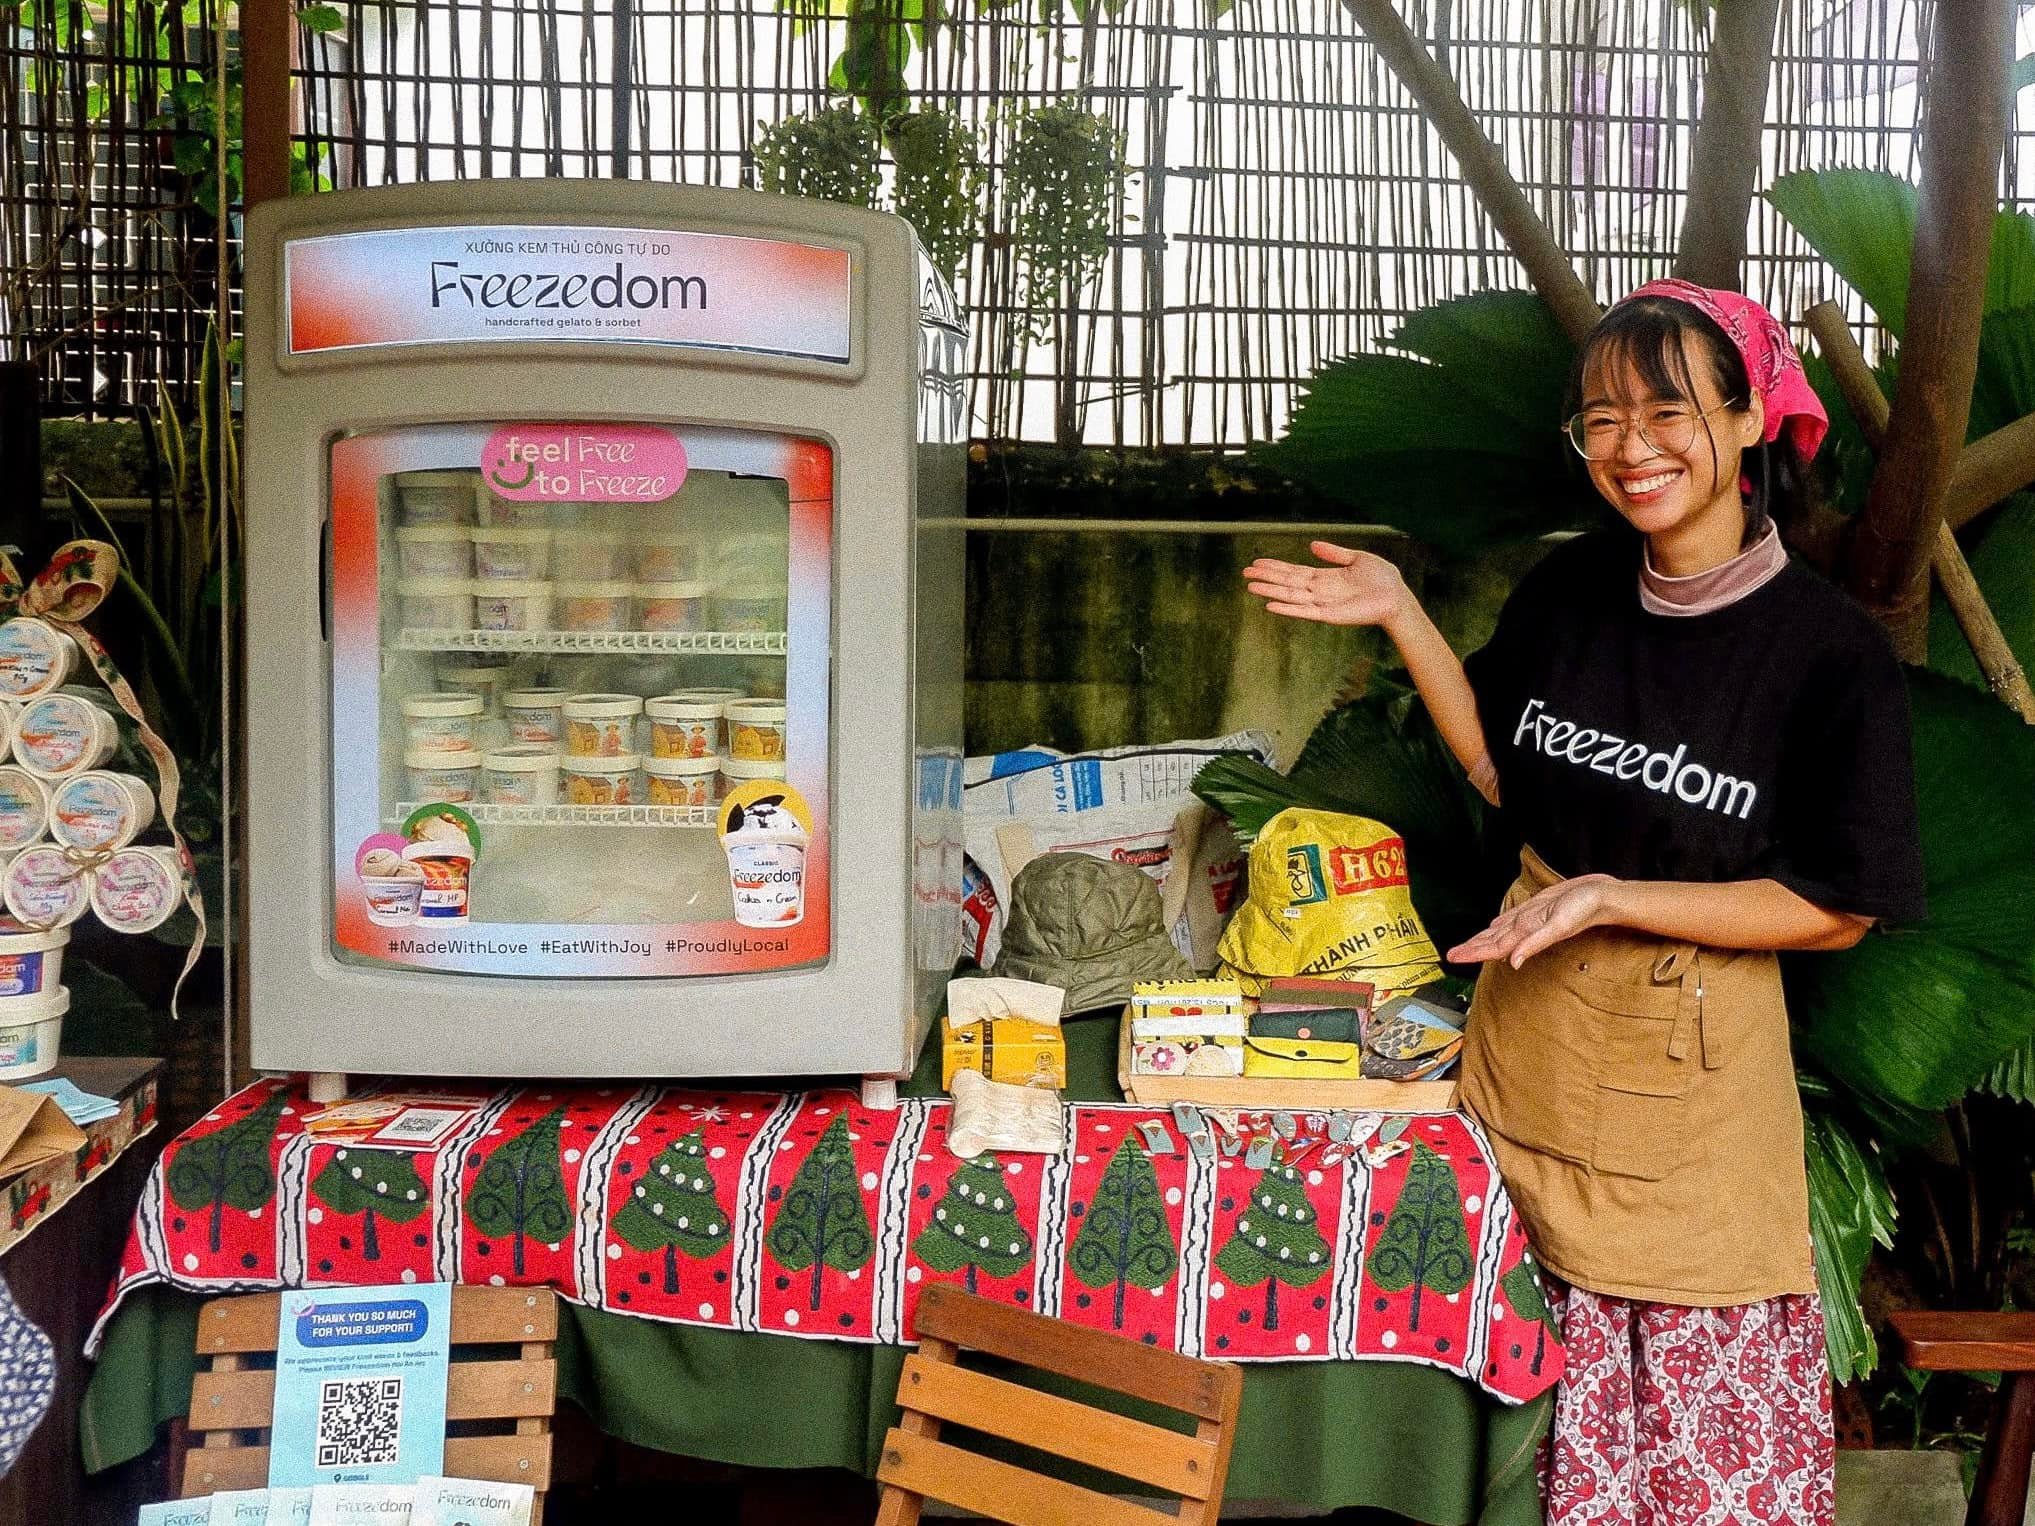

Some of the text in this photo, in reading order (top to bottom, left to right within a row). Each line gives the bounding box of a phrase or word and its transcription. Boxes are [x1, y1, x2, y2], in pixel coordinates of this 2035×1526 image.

[465, 240, 671, 257] XƯỞNG KEM THỦ CÔNG TỰ DO
[431, 261, 707, 309] Freezedom
[485, 316, 641, 329] handcrafted gelato & sorbet
[506, 436, 635, 463] feel Free
[534, 469, 666, 496] to Freeze
[1513, 698, 1757, 819] Freezedom
[734, 868, 801, 883] Freezedom
[387, 939, 790, 957] #MadeWithLove #EatWithJoy #ProudlyLocal
[312, 1309, 416, 1324] THANK YOU SO MUCH
[313, 1322, 414, 1338] FOR YOUR SUPPORT!
